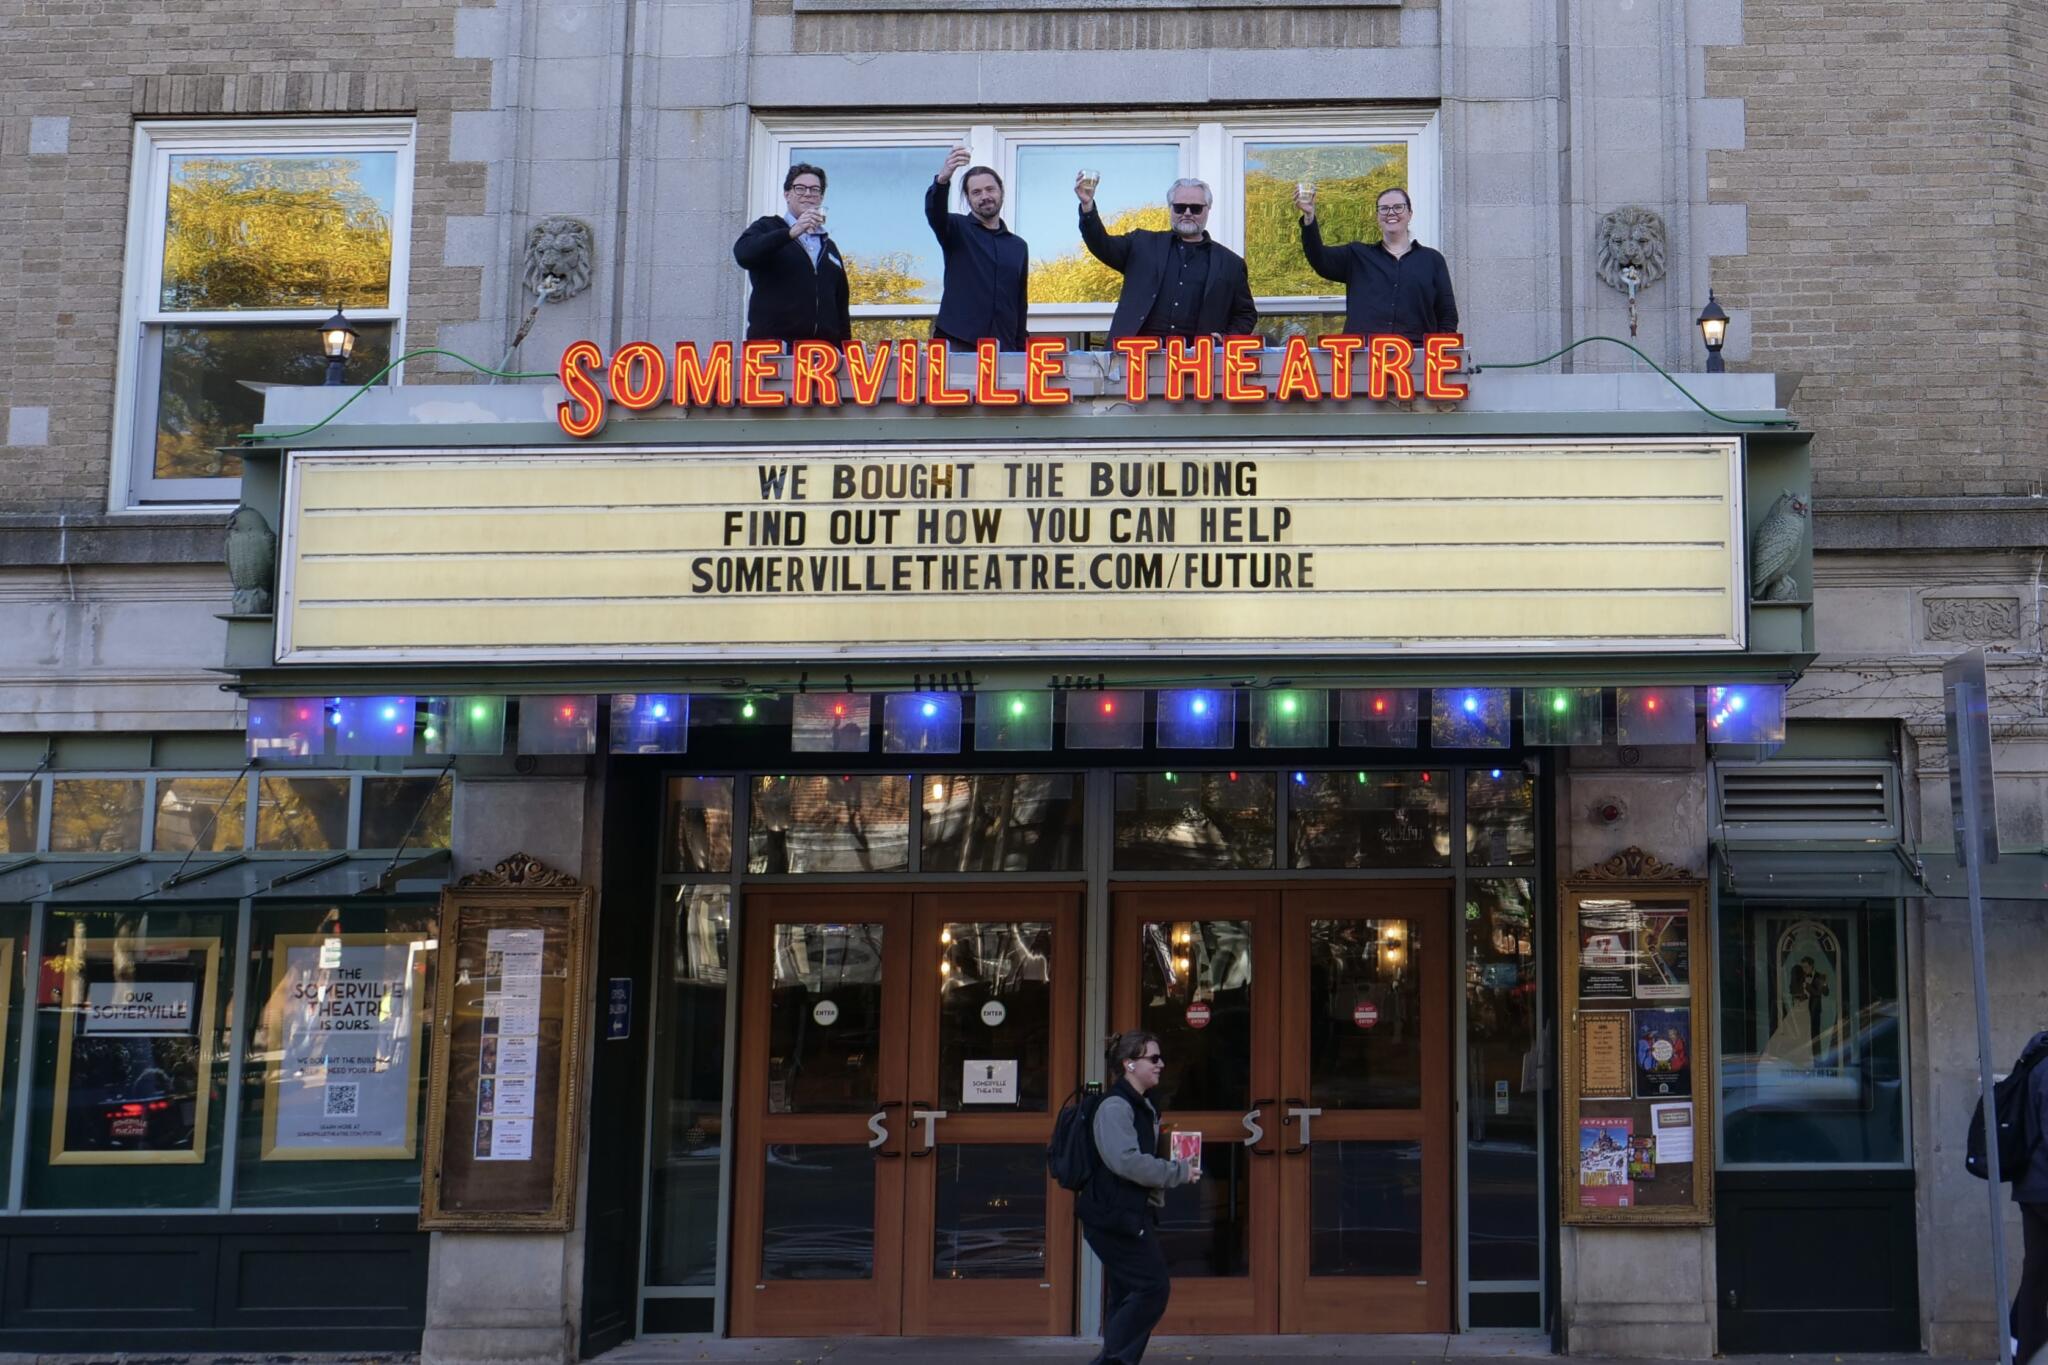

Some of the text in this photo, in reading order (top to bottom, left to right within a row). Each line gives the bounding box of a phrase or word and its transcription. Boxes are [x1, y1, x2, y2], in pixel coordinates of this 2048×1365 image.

[557, 333, 1469, 438] SOMERVILLE THEATRE
[758, 461, 1258, 500] WE BOUGHT THE BUILDING
[724, 506, 1292, 546] FIND OUT HOW YOU CAN HELP
[692, 553, 1314, 593] SOMERVILLETHEATRE.COM/FUTURE
[338, 968, 362, 979] THE
[126, 992, 153, 1002] OUR
[308, 1001, 388, 1016] THEATR
[93, 1005, 187, 1019] SOMERVILLE
[320, 1020, 373, 1030] IS OURS.
[310, 1056, 339, 1064] BOUHT
[867, 1110, 947, 1148] S T
[1242, 1108, 1322, 1146] S T
